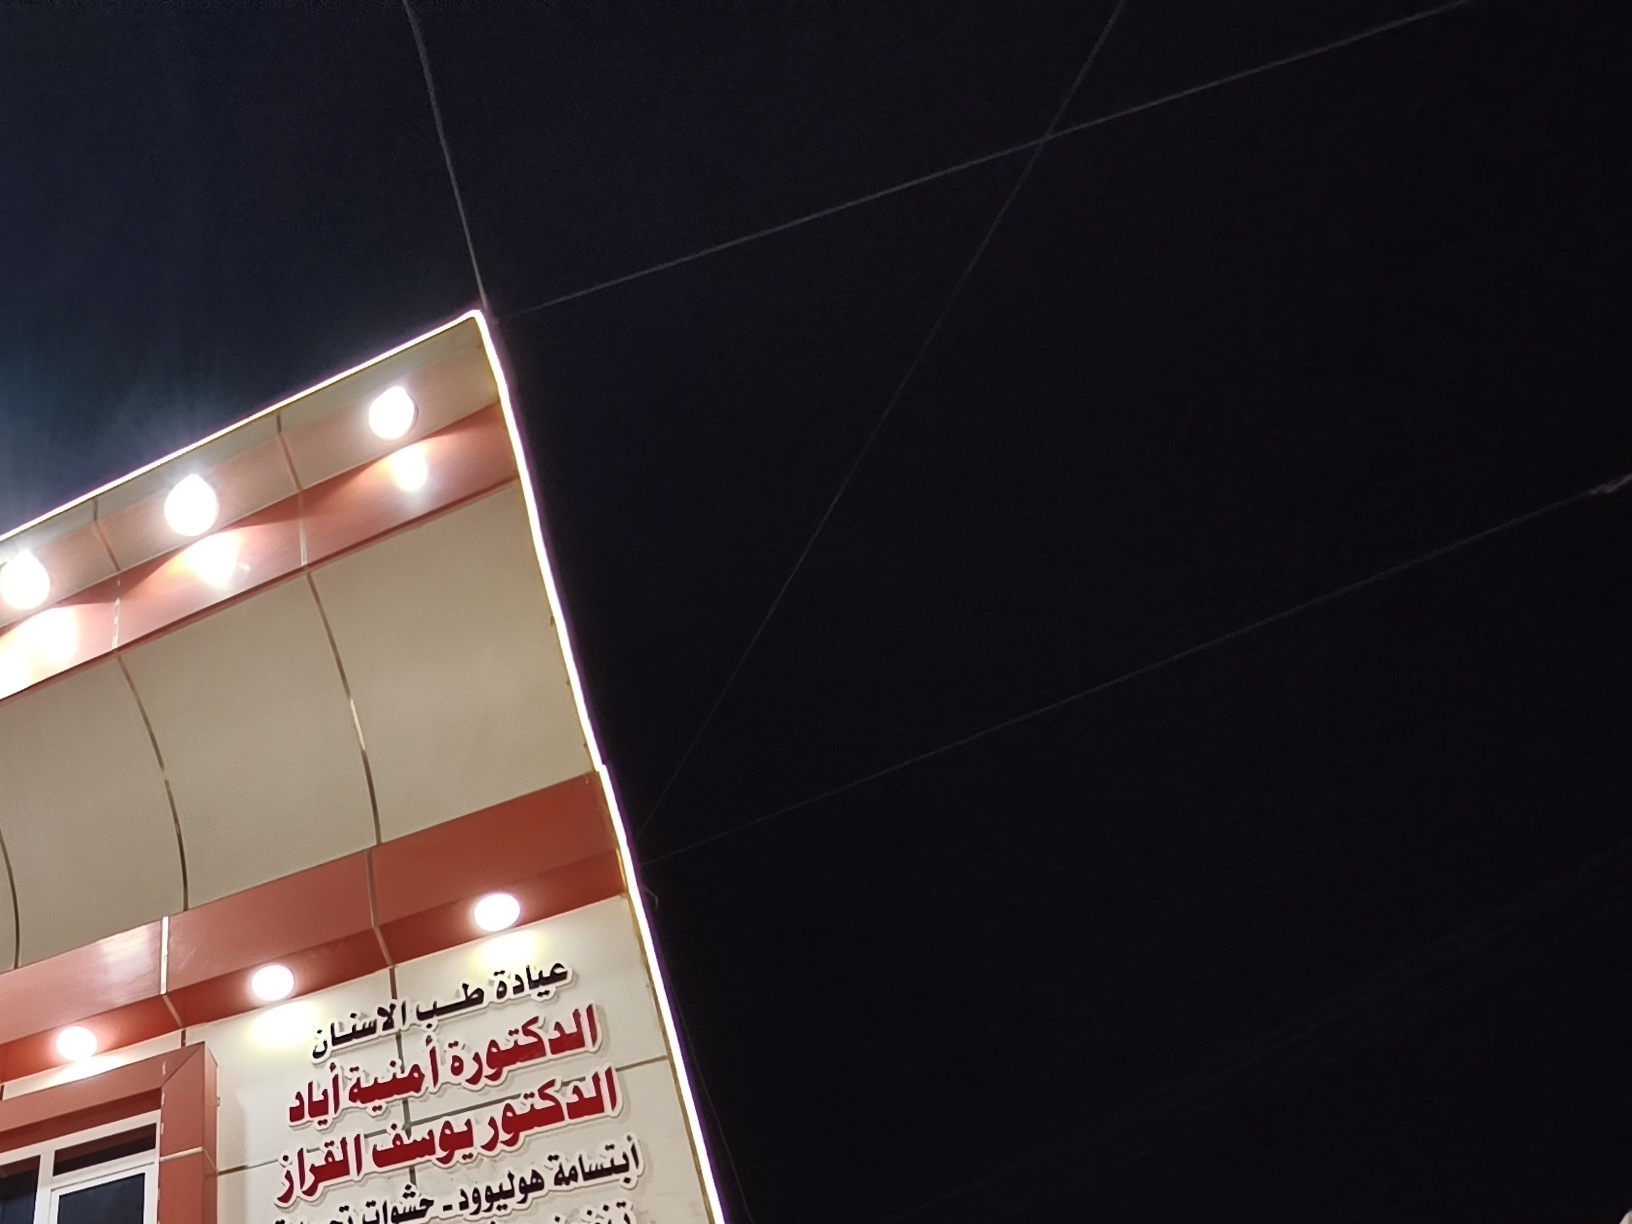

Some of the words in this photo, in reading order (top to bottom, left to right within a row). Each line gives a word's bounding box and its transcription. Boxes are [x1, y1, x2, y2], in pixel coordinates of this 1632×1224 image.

[417, 983, 485, 1029] طب
[494, 963, 568, 1000] عيادة
[312, 1001, 407, 1060] الاسنان
[447, 1004, 597, 1087] الدكتورة
[289, 1062, 341, 1126] أياد
[349, 1035, 439, 1112] أمنية
[480, 1067, 617, 1152] الدكتور
[372, 1117, 474, 1168] يوسف
[458, 1169, 545, 1216] هوليوود
